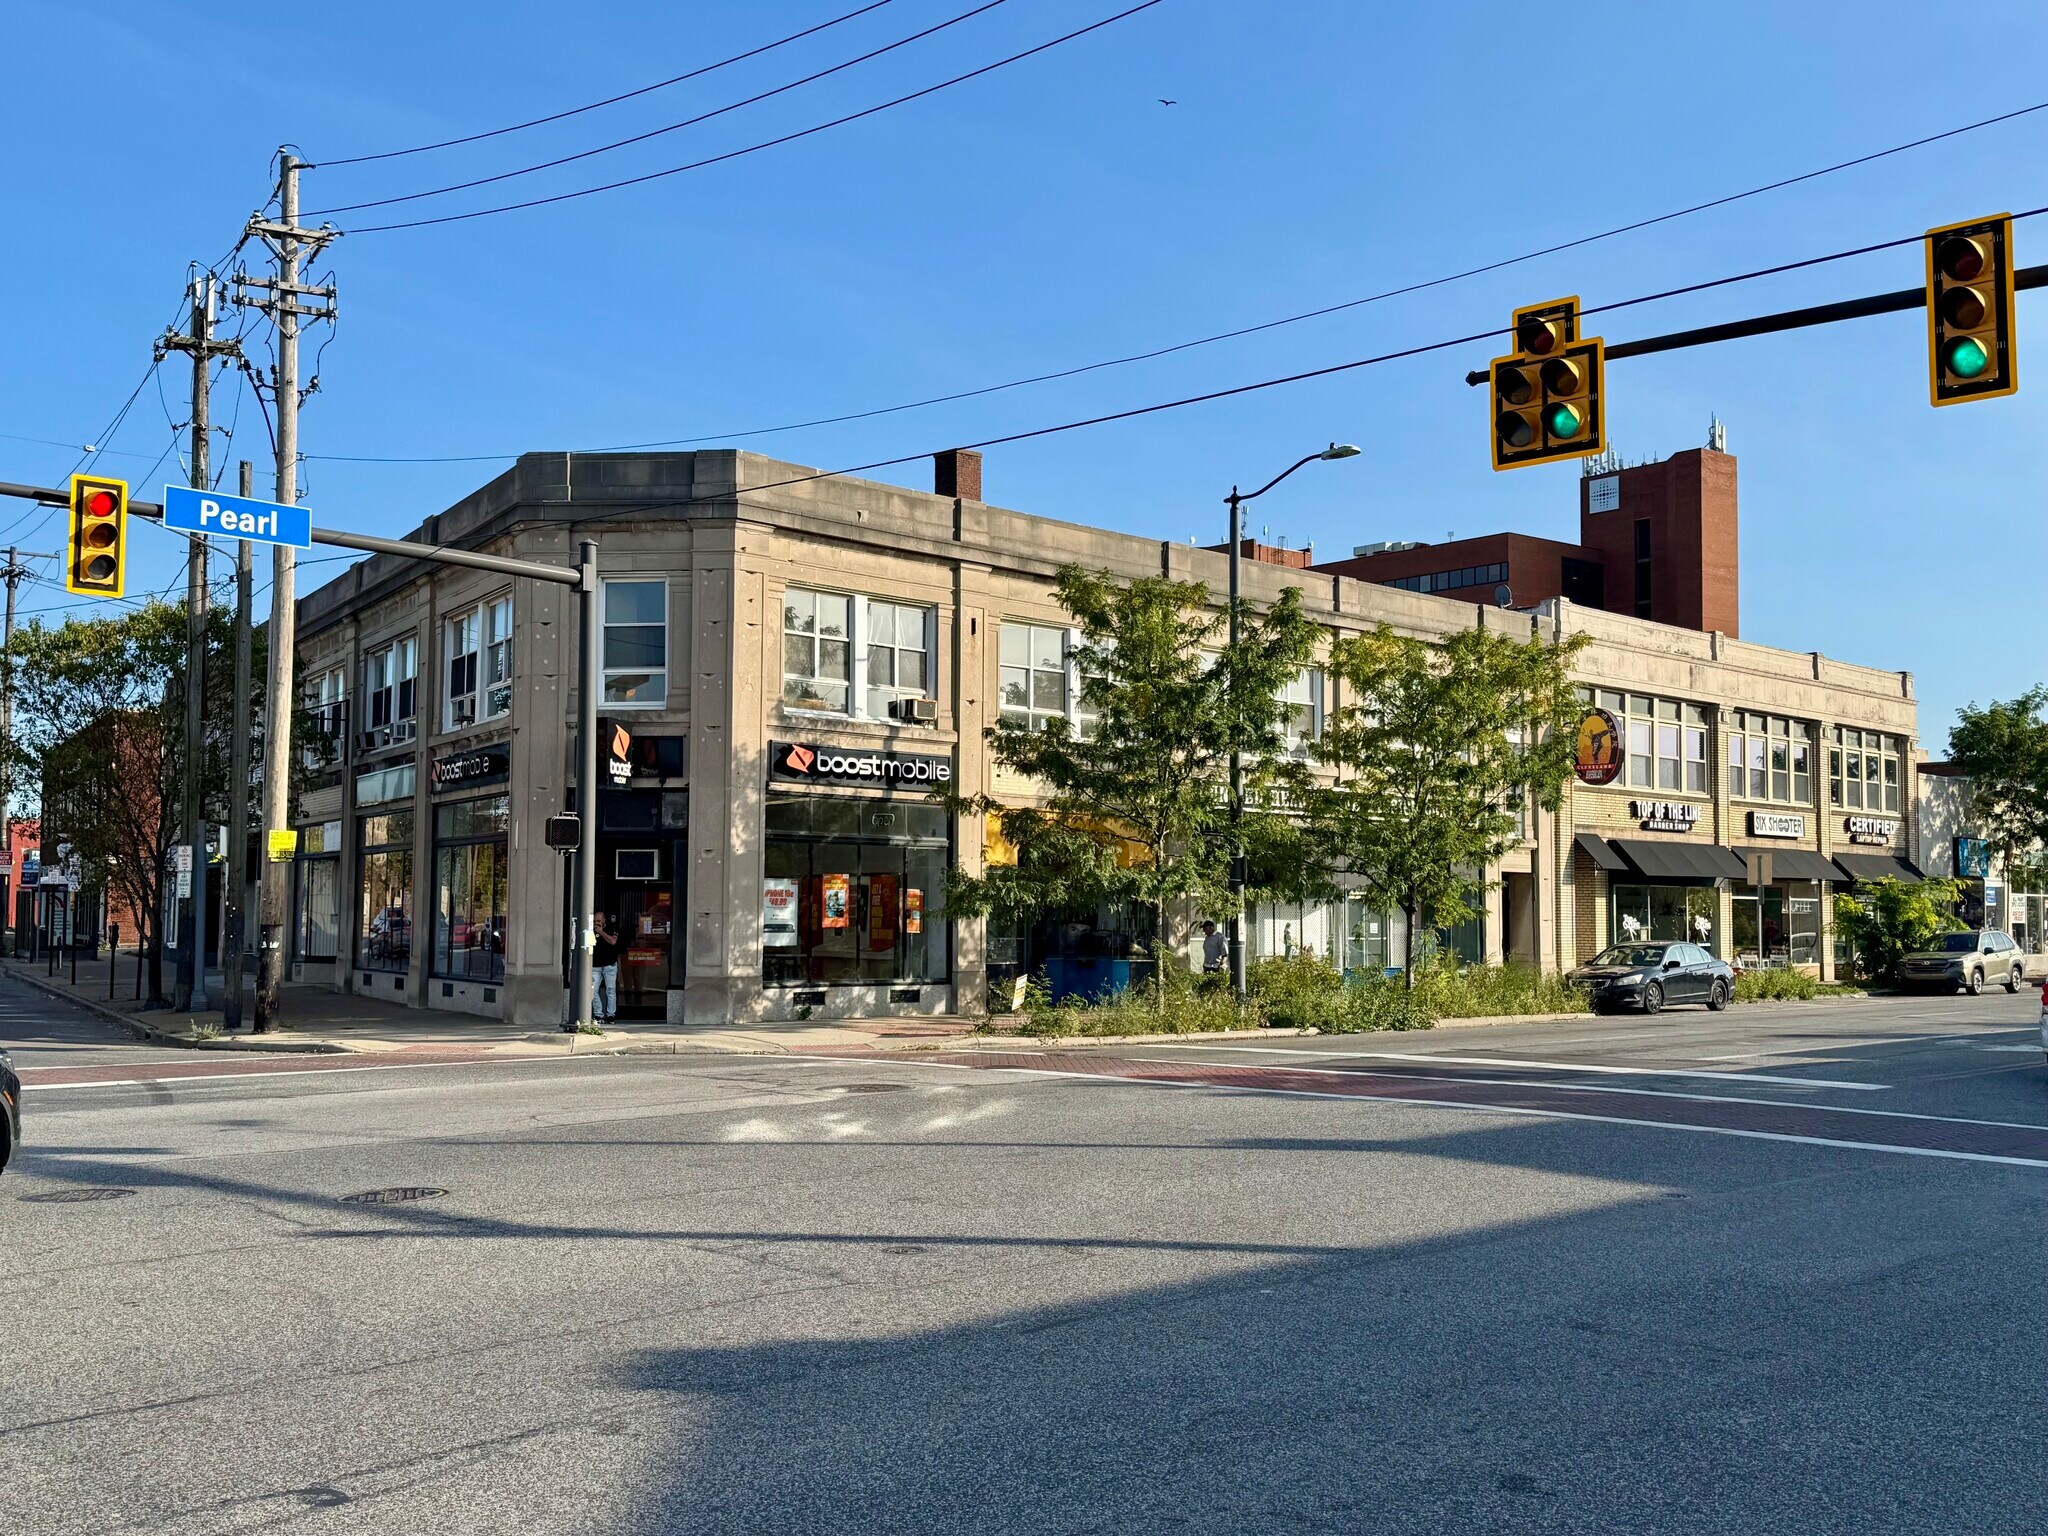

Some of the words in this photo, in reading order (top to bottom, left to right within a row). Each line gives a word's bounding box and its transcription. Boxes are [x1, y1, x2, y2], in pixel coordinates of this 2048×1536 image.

[200, 499, 278, 537] Pearl
[441, 755, 490, 781] boostmobe
[610, 758, 631, 777] boost
[1636, 800, 1653, 818] TOP
[1654, 802, 1666, 819] OF
[1667, 803, 1684, 820] THE
[1684, 804, 1702, 822] LINE
[1649, 820, 1674, 829] BARBER
[1674, 822, 1690, 831] SHOP
[1755, 815, 1767, 832] SIX
[1768, 816, 1803, 834] SHOOTER
[1850, 816, 1896, 835] CERTIFIED
